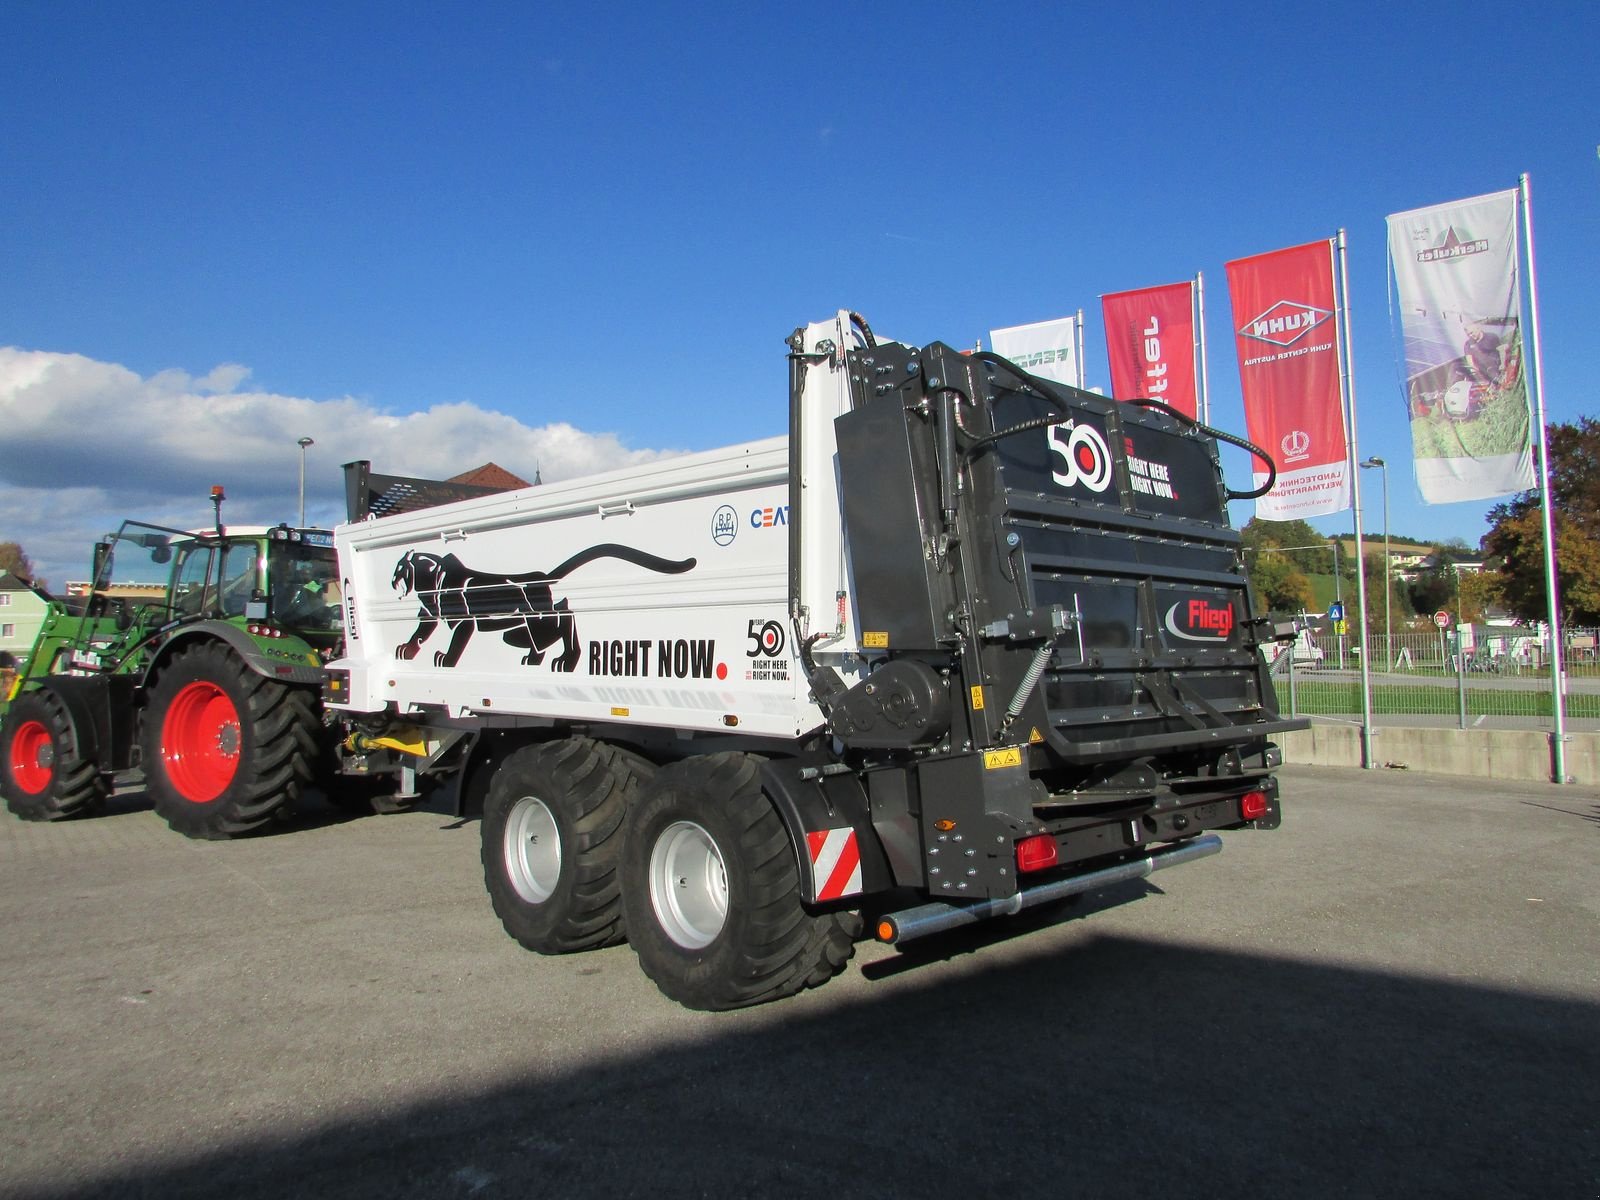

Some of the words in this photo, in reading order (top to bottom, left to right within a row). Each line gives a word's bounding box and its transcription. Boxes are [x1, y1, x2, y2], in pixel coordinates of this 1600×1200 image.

[1047, 412, 1112, 493] 50
[1126, 455, 1149, 476] RIGHT
[1149, 462, 1169, 482] HERE
[1130, 474, 1154, 495] RIGHT
[1188, 600, 1233, 637] Fliegl
[746, 619, 785, 657] 50
[589, 640, 652, 677] RIGHT
[752, 660, 771, 669] RIGHT
[772, 660, 787, 669] HERE
[752, 671, 771, 680] RIGHT
